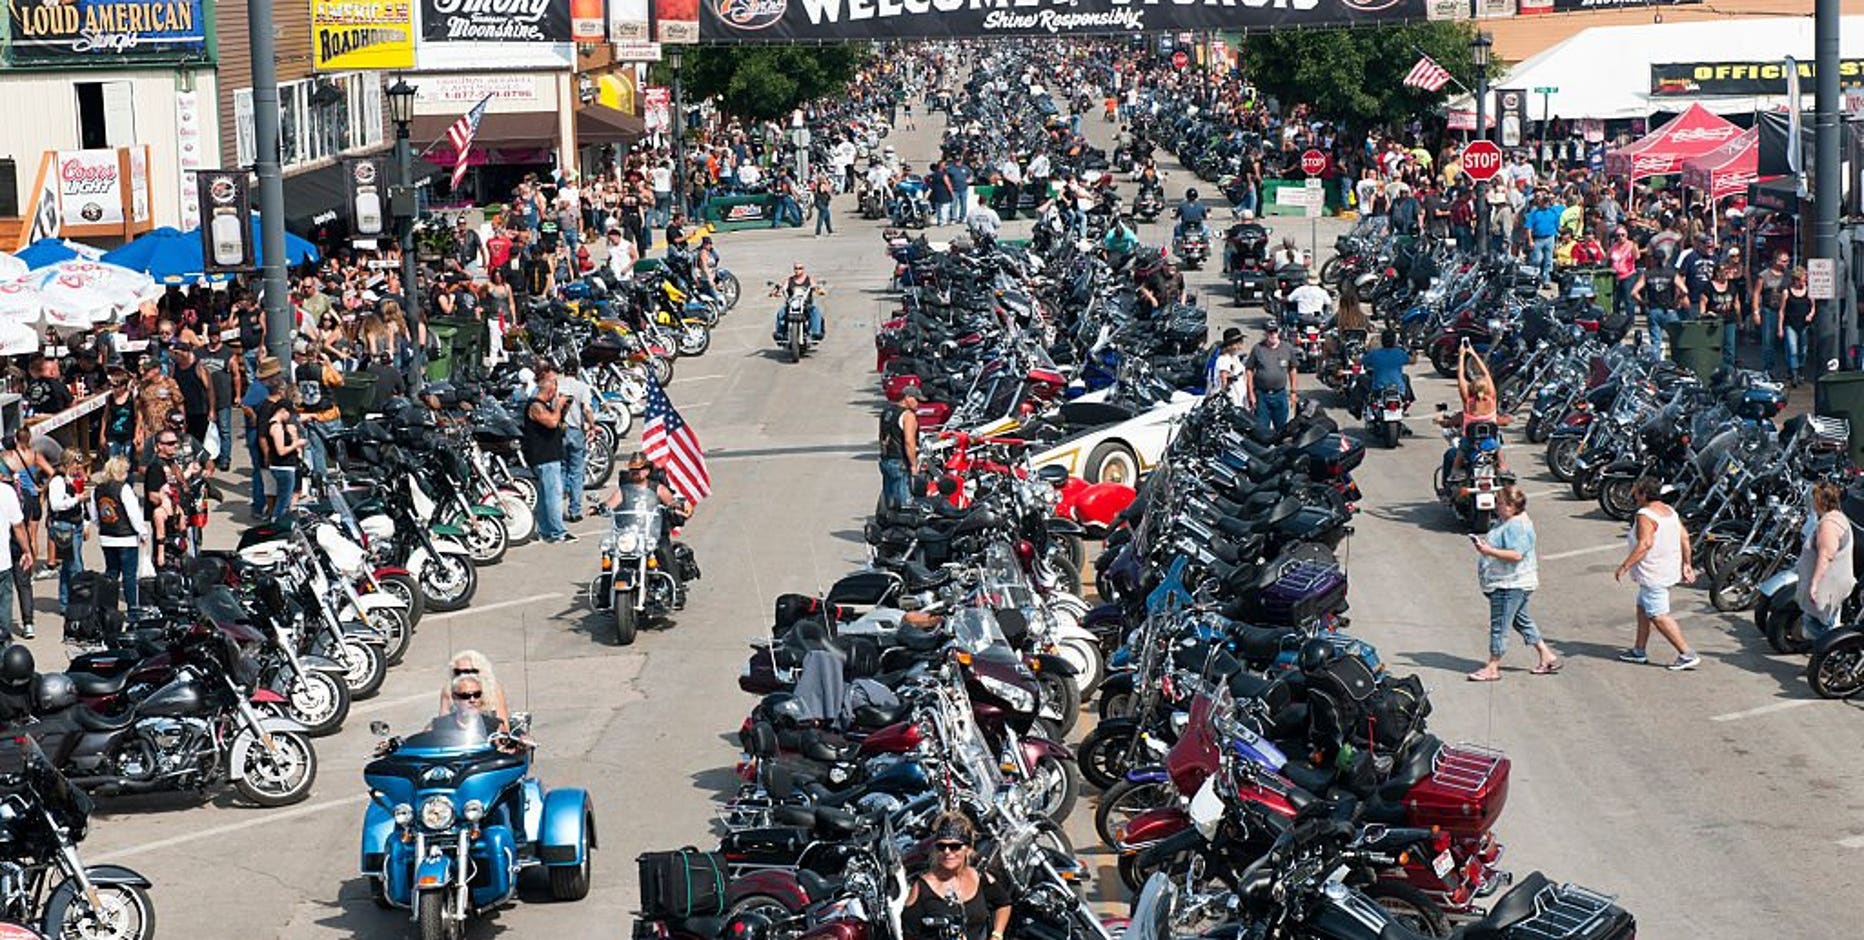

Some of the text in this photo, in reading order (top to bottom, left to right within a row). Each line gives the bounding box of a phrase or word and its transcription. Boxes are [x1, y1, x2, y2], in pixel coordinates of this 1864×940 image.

[22, 2, 192, 36] LOUD AMERICAN
[316, 3, 409, 24] AMERICAN
[983, 10, 1038, 29] Shine
[447, 16, 545, 41] Moonshine
[1694, 65, 1815, 81] OFFICIA
[62, 158, 117, 182] Coors
[1301, 157, 1325, 167] STOP
[1464, 152, 1499, 169] STOP
[64, 180, 115, 196] LIGHT
